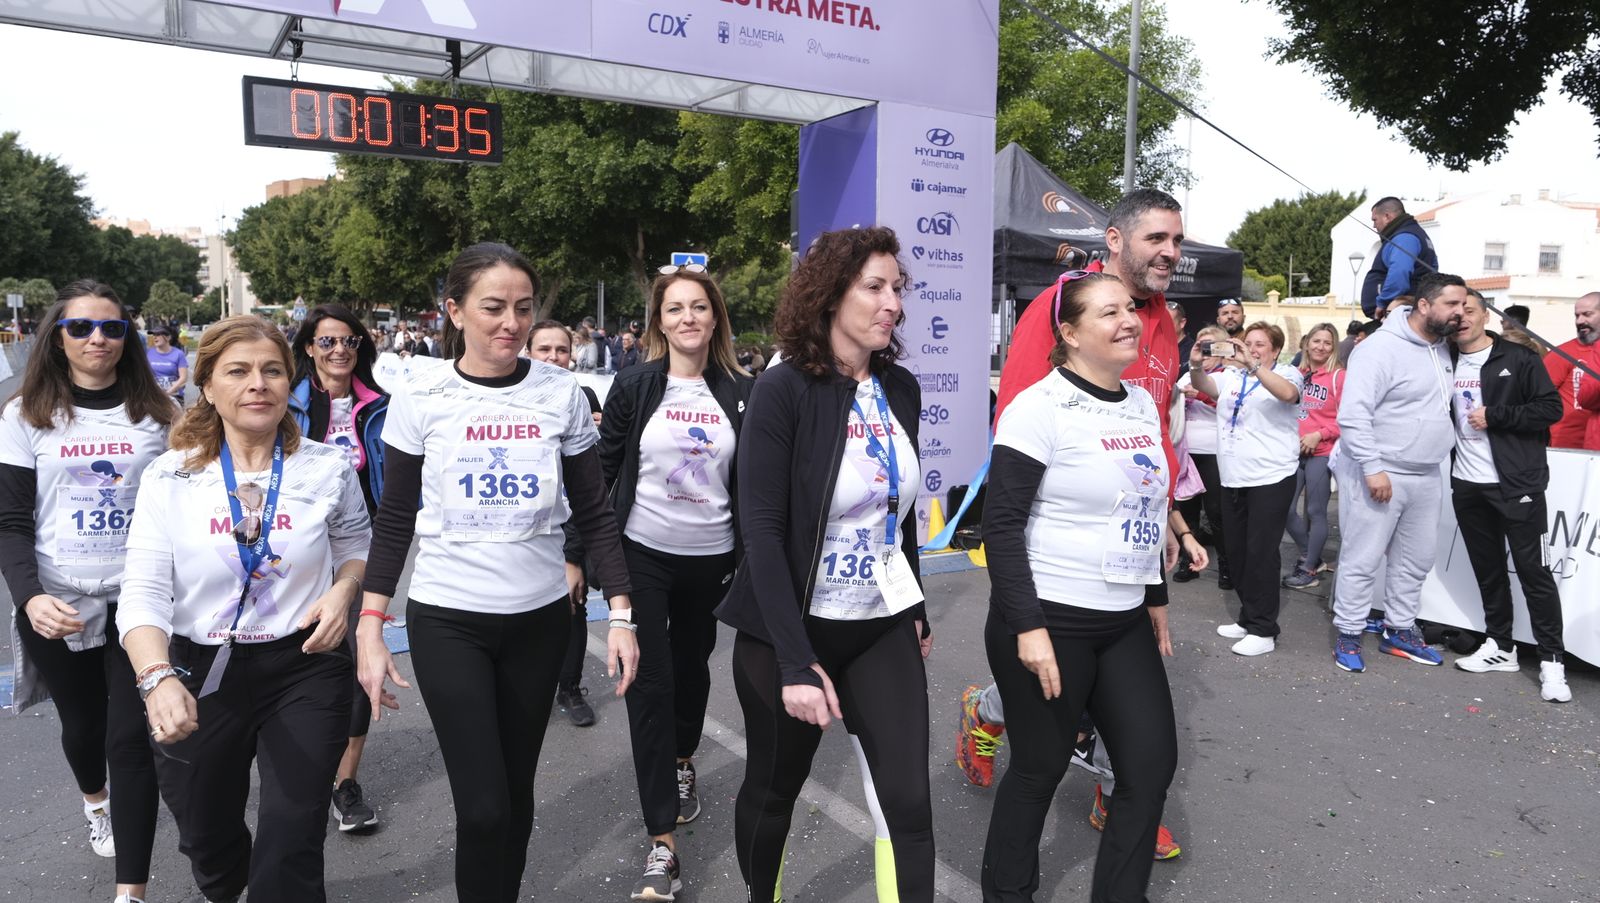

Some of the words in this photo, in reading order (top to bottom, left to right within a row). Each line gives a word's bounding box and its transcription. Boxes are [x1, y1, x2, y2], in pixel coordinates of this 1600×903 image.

[807, 0, 881, 31] META.
[648, 13, 692, 38] CDX
[739, 26, 785, 44] ALMERÍA
[290, 88, 491, 156] 00:01:35
[915, 147, 965, 160] HYUNDAI
[927, 182, 967, 194] cajamar
[928, 249, 963, 261] vithas
[920, 288, 962, 303] aqualia
[921, 344, 949, 355] Clece
[936, 373, 958, 392] CASH
[470, 414, 511, 423] CARRERA
[666, 410, 721, 424] MUJER
[920, 404, 949, 425] ego
[466, 424, 542, 441] MUJER
[847, 423, 897, 439] MUER
[61, 442, 134, 458] MUJER
[1101, 434, 1156, 451] MUJER
[458, 473, 540, 499] 1363
[825, 535, 850, 544] MUJER
[1121, 518, 1160, 546] 1359
[823, 552, 876, 580] 136
[825, 577, 850, 586] MARIA
[852, 579, 866, 587] DEL
